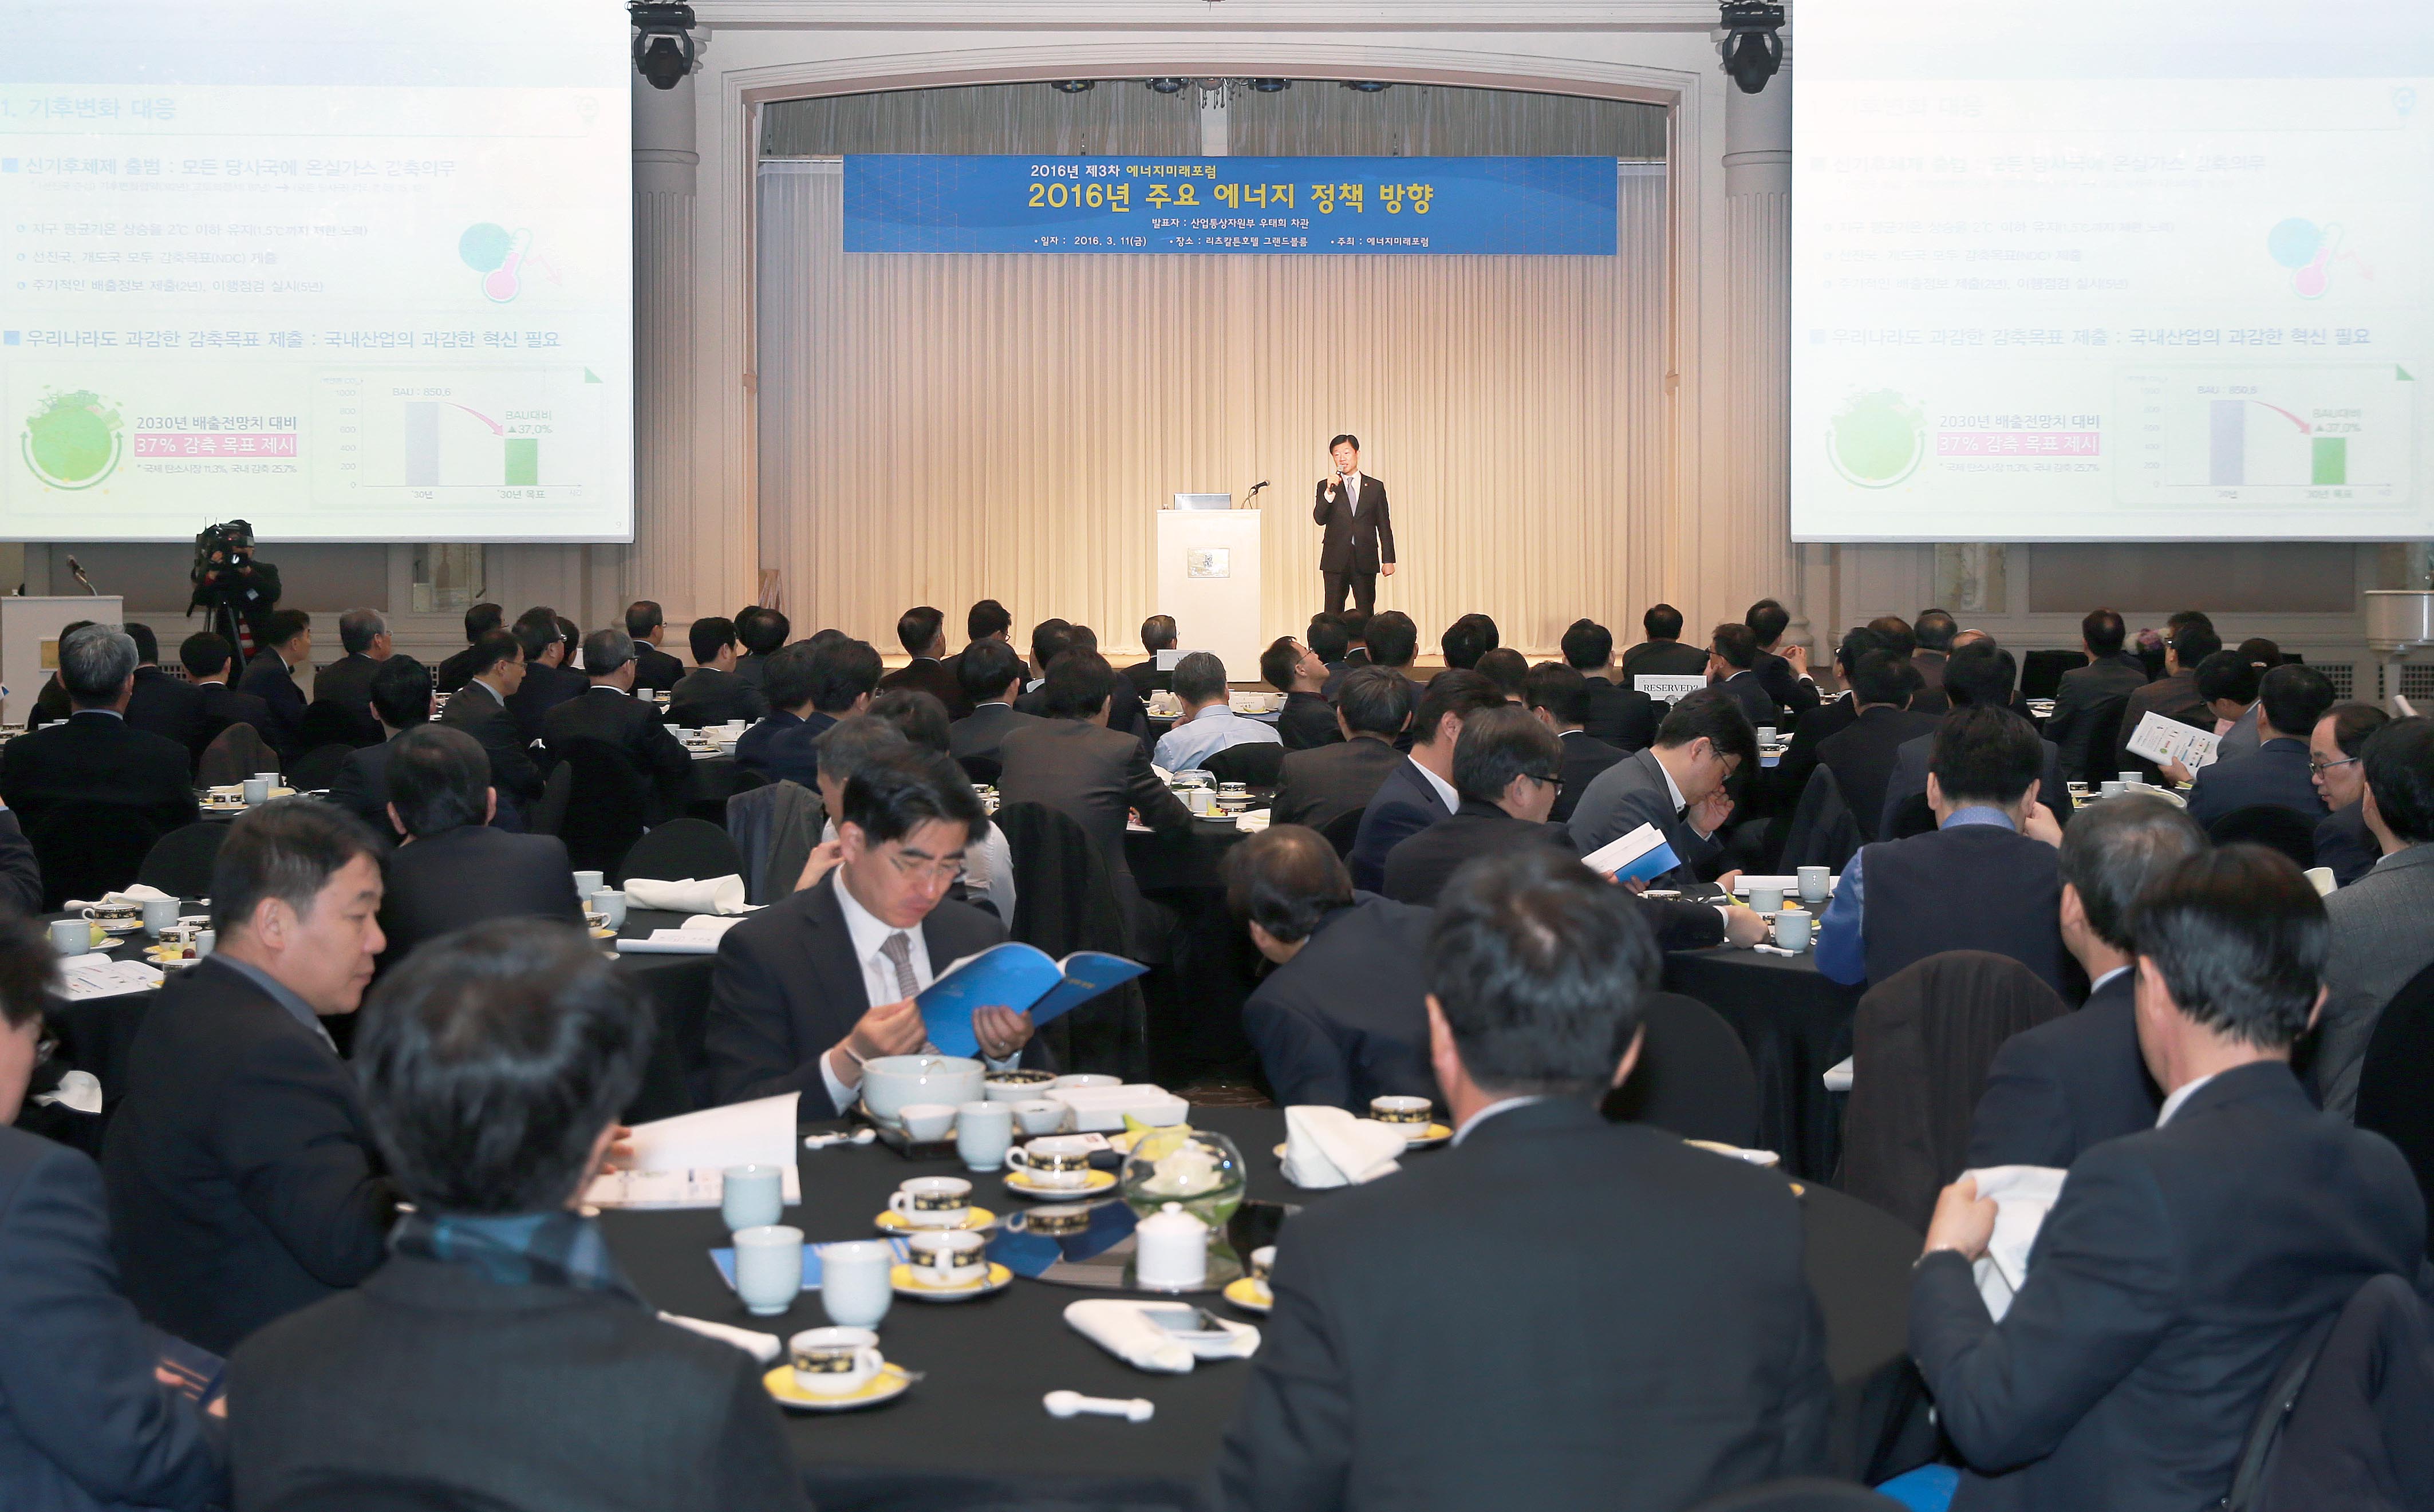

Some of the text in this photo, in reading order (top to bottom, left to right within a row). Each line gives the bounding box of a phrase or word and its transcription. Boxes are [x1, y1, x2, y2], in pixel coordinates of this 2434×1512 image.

[29, 97, 119, 120] 기후변화
[131, 97, 176, 120] 대응
[26, 157, 116, 175] 신기후체제
[125, 157, 161, 176] 출범
[182, 157, 218, 175] 모든
[226, 157, 297, 176] 당사국에
[306, 159, 377, 177] 온실가스
[1031, 164, 1217, 180] 2016년 제3차 에너지미래포럼
[1028, 183, 1433, 214] 2016년 주요 에너지 정책 방향
[33, 223, 58, 236] 지구
[64, 223, 116, 237] 평균기온
[123, 223, 162, 236] 상승을
[195, 223, 221, 236] 이하
[1151, 219, 1179, 228] 발표자
[1191, 219, 1255, 228] 산업통상자원부
[1260, 219, 1287, 228] 우태희
[1291, 219, 1309, 228] 차관
[1040, 236, 1059, 245] 일자
[1074, 236, 1102, 245] 2016.
[1107, 237, 1116, 245] 3.
[1121, 236, 1147, 247] 11(금)
[1175, 236, 1194, 247] 장소
[1206, 236, 1259, 247] 리츠칼튼호텔
[1264, 237, 1308, 247] 그랜드볼룸
[1337, 237, 1355, 246] 주최
[1367, 237, 1429, 247] 에너지미래포럼
[82, 251, 122, 264] 개도국
[127, 252, 152, 264] 모두
[33, 279, 85, 292] 주기적인
[92, 279, 144, 293] 배출정보
[213, 279, 265, 293] 이행점검
[27, 330, 118, 348] 우리나라도
[125, 330, 180, 348] 과감한
[188, 330, 261, 348] 감축목표
[269, 330, 303, 348] 제출
[324, 331, 414, 348] 국내산업의
[421, 331, 475, 348] 과감한
[483, 331, 518, 348] 혁신
[525, 331, 561, 348] 필요
[1832, 328, 2371, 346] 우리나라도 과감한 감축목표 제출 국내산업의 과감한 혁신 필요
[392, 388, 413, 396] BAU
[505, 410, 552, 421] BAU대비
[1939, 414, 2100, 429] 2030년 배출전망치 대비
[137, 416, 297, 431] 2030년 배출전망치 대비
[137, 437, 293, 454] 37% 감축 목표 제시
[1939, 435, 2097, 452] 37% 감축 목표 제시
